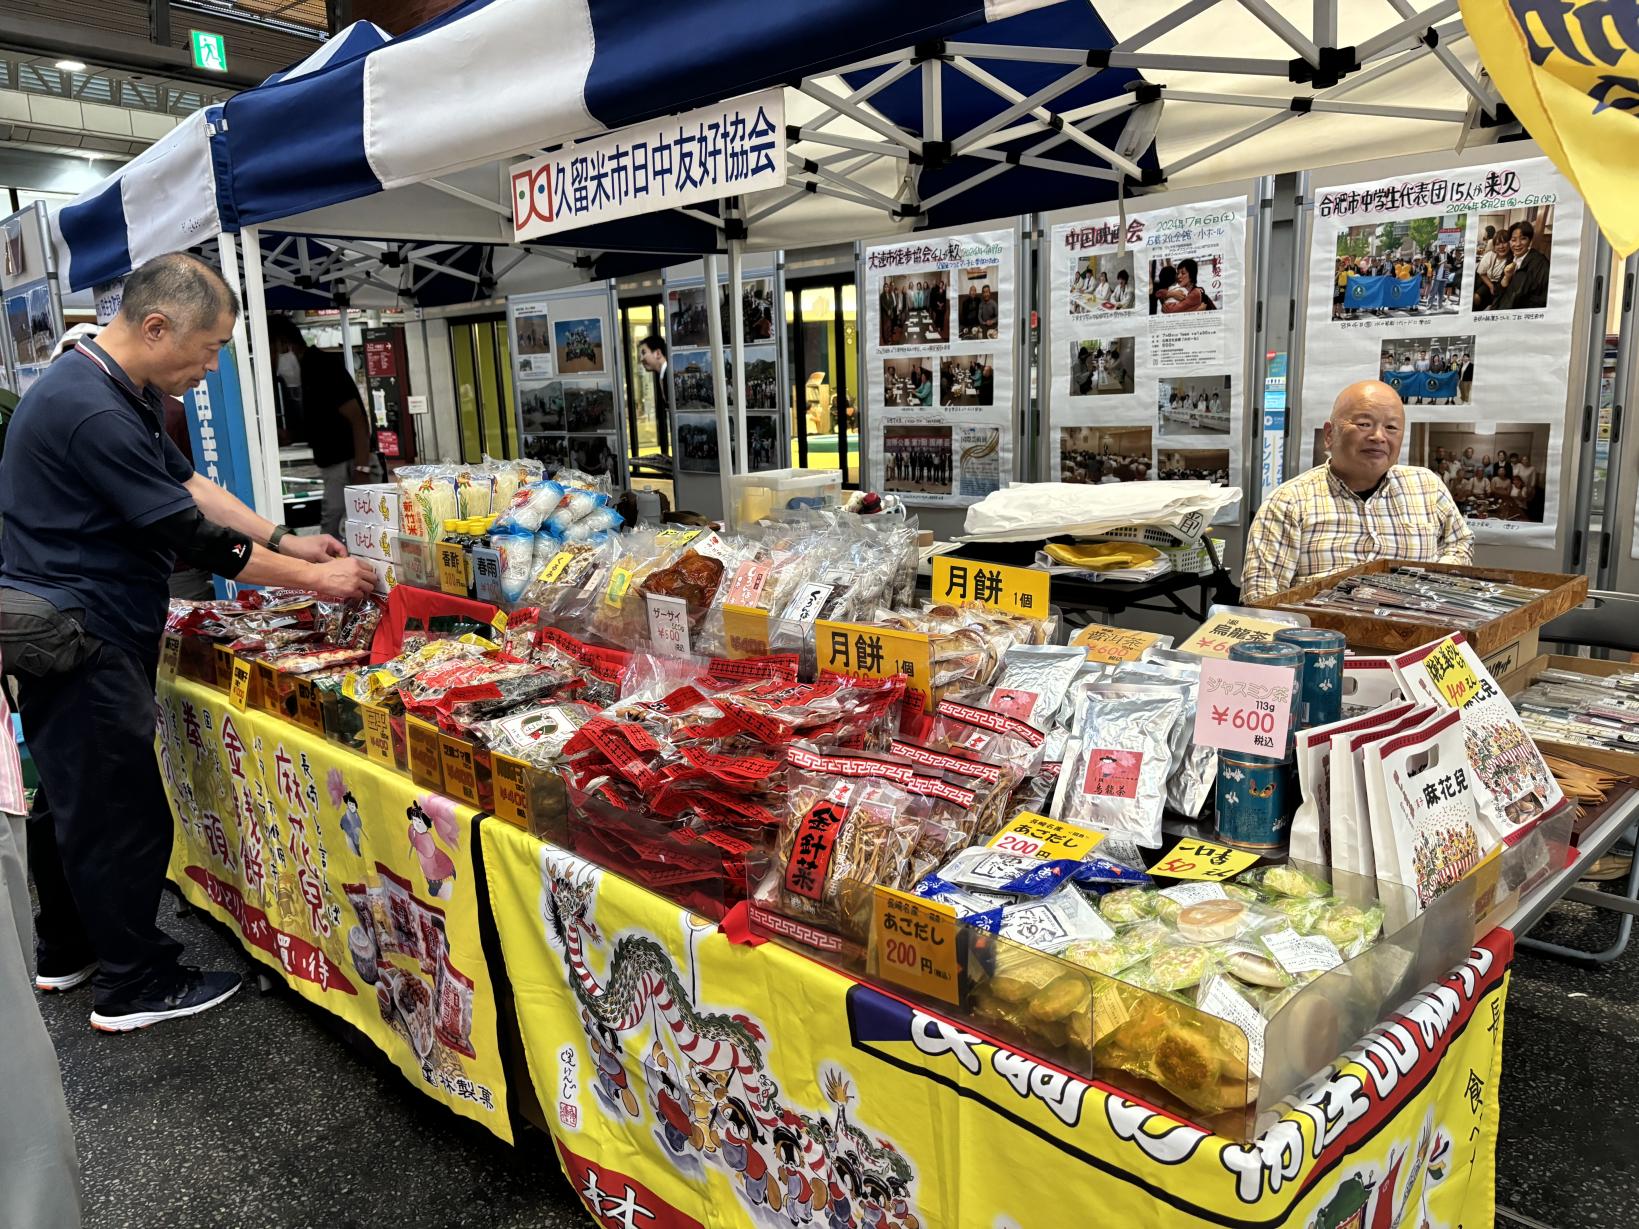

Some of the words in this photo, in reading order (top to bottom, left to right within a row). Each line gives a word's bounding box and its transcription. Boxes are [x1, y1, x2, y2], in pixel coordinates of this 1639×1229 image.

[554, 106, 776, 219] 久留米市日中友好協会
[945, 565, 1004, 605] 月餅
[1014, 592, 1033, 609] 1個
[829, 631, 884, 673] 月餅
[895, 659, 915, 678] 1個
[1206, 676, 1289, 703] ジャスミン茶
[1211, 704, 1275, 734] ¥600
[1256, 700, 1276, 712] 113g
[1253, 734, 1274, 748] 税込
[1422, 767, 1469, 809] 麻花兒
[791, 806, 841, 892] 金針菜
[996, 836, 1040, 855] 200
[1012, 823, 1079, 849] あごだし
[883, 911, 945, 946] あごだし
[886, 938, 917, 967] 200
